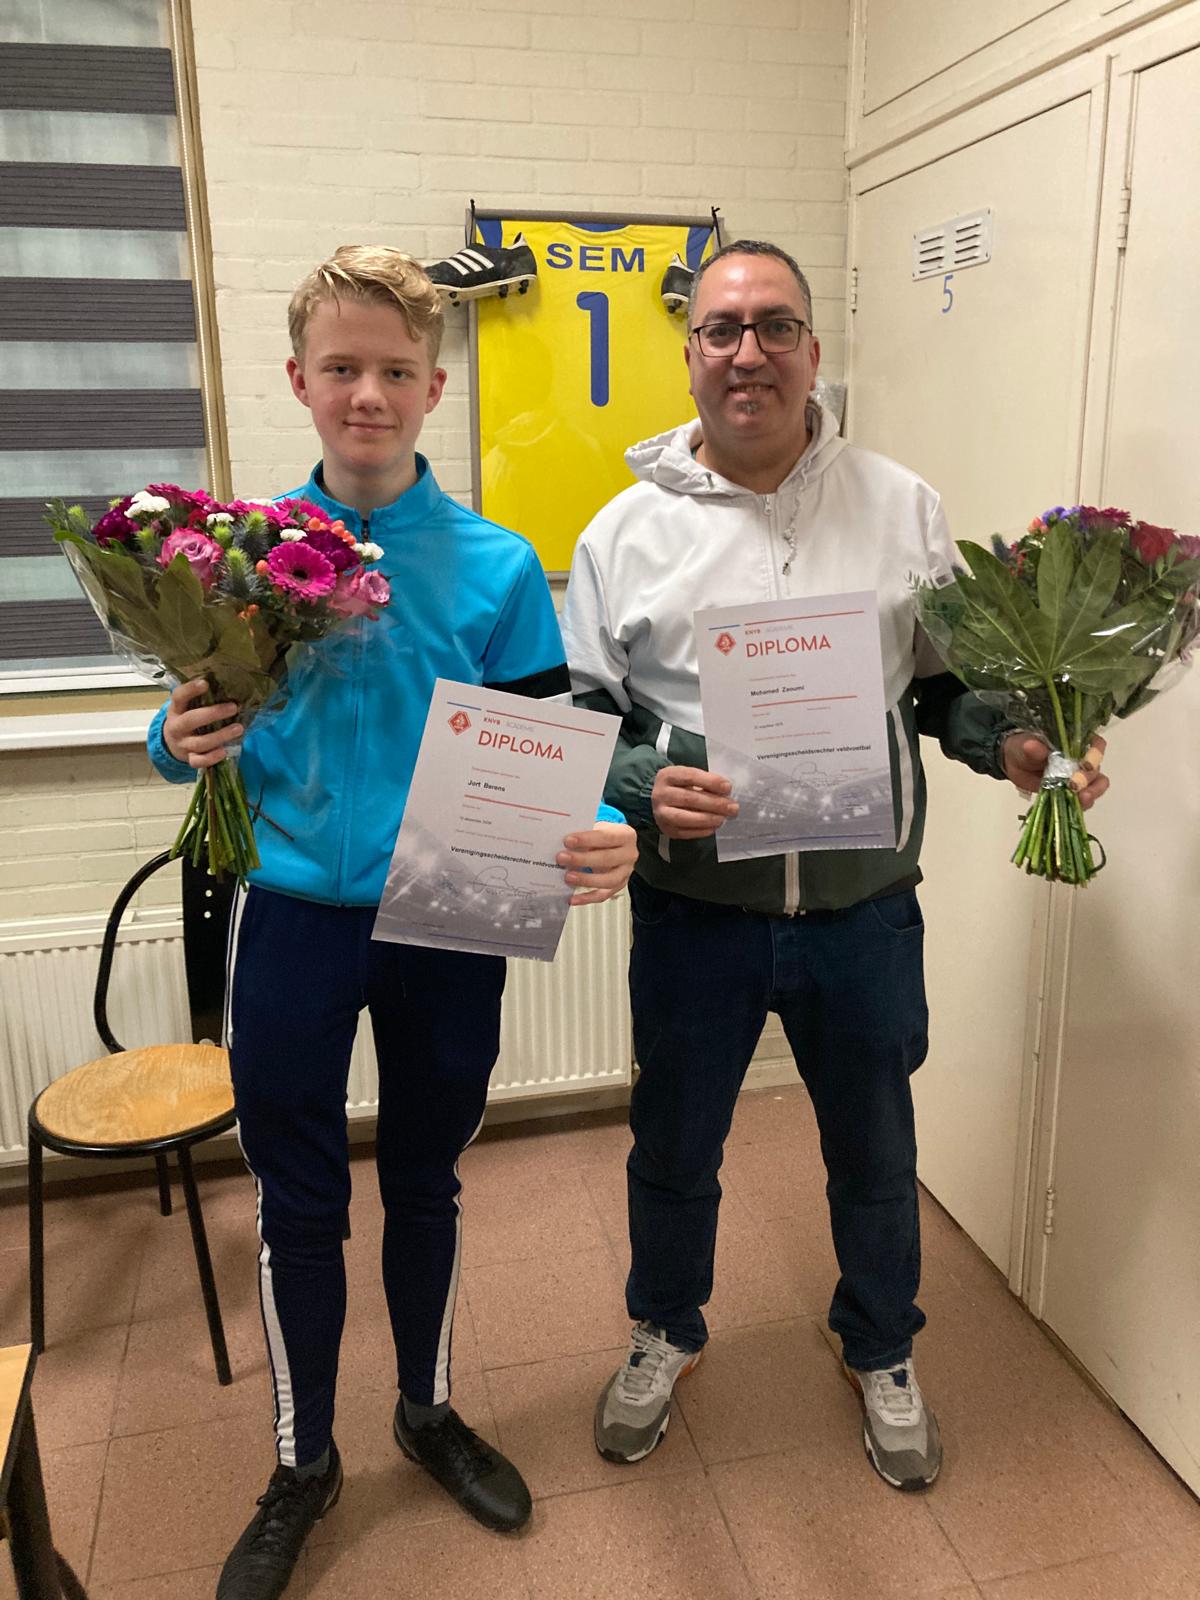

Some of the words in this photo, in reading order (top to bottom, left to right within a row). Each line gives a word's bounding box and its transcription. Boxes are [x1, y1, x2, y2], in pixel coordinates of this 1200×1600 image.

[546, 243, 645, 273] SEM
[942, 274, 954, 313] 5
[576, 291, 609, 407] 1
[746, 634, 832, 658] DIPLOMA
[751, 687, 779, 696] Mohamed
[478, 730, 564, 762] DIPLOMA
[468, 779, 481, 788] Jort
